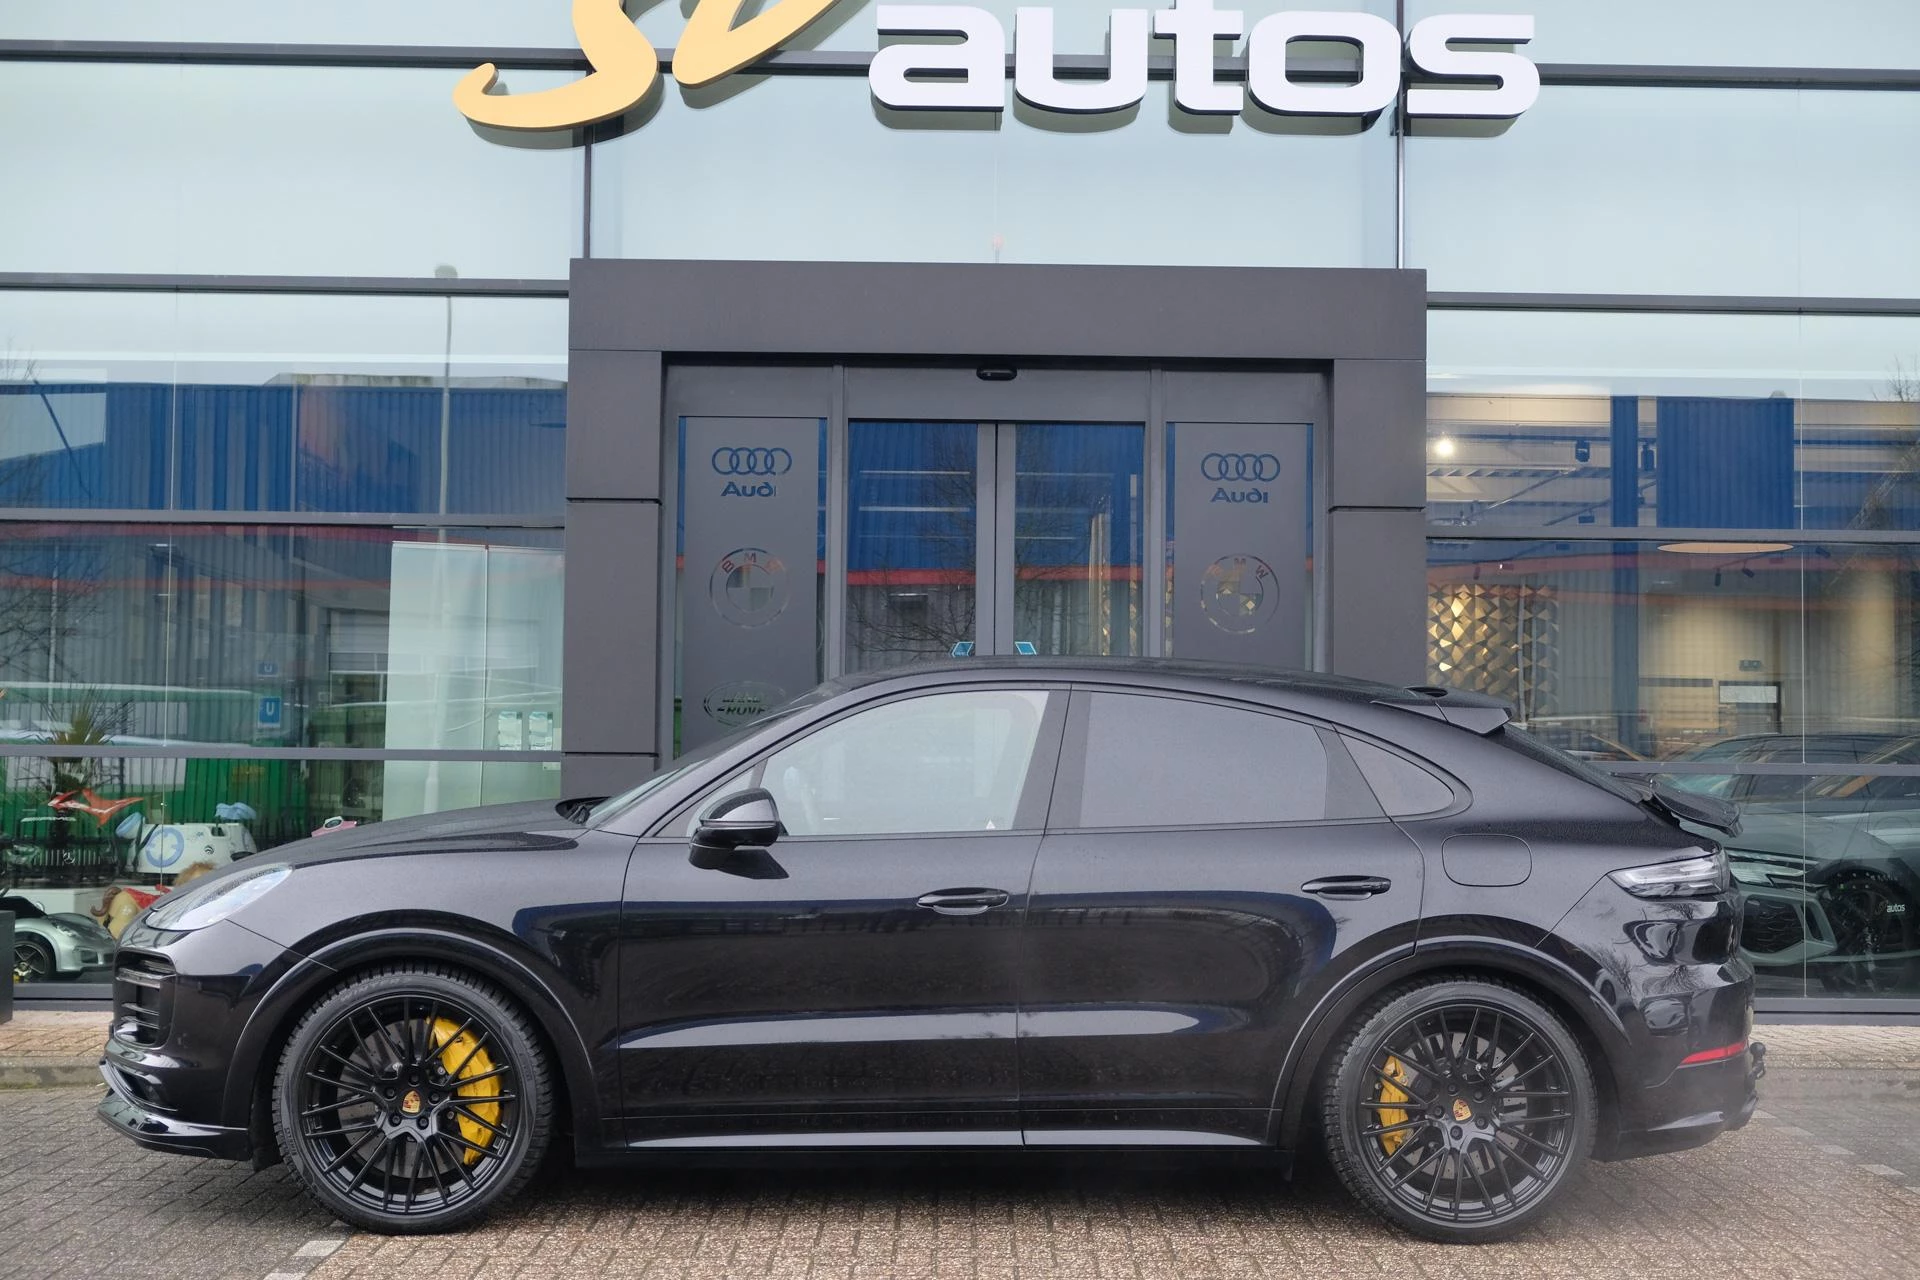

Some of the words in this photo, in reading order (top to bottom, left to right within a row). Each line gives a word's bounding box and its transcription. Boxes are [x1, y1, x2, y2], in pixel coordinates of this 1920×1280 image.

[868, 0, 1541, 119] autos
[720, 481, 777, 498] Audi
[1210, 487, 1269, 504] Audi
[1886, 903, 1906, 913] autos
